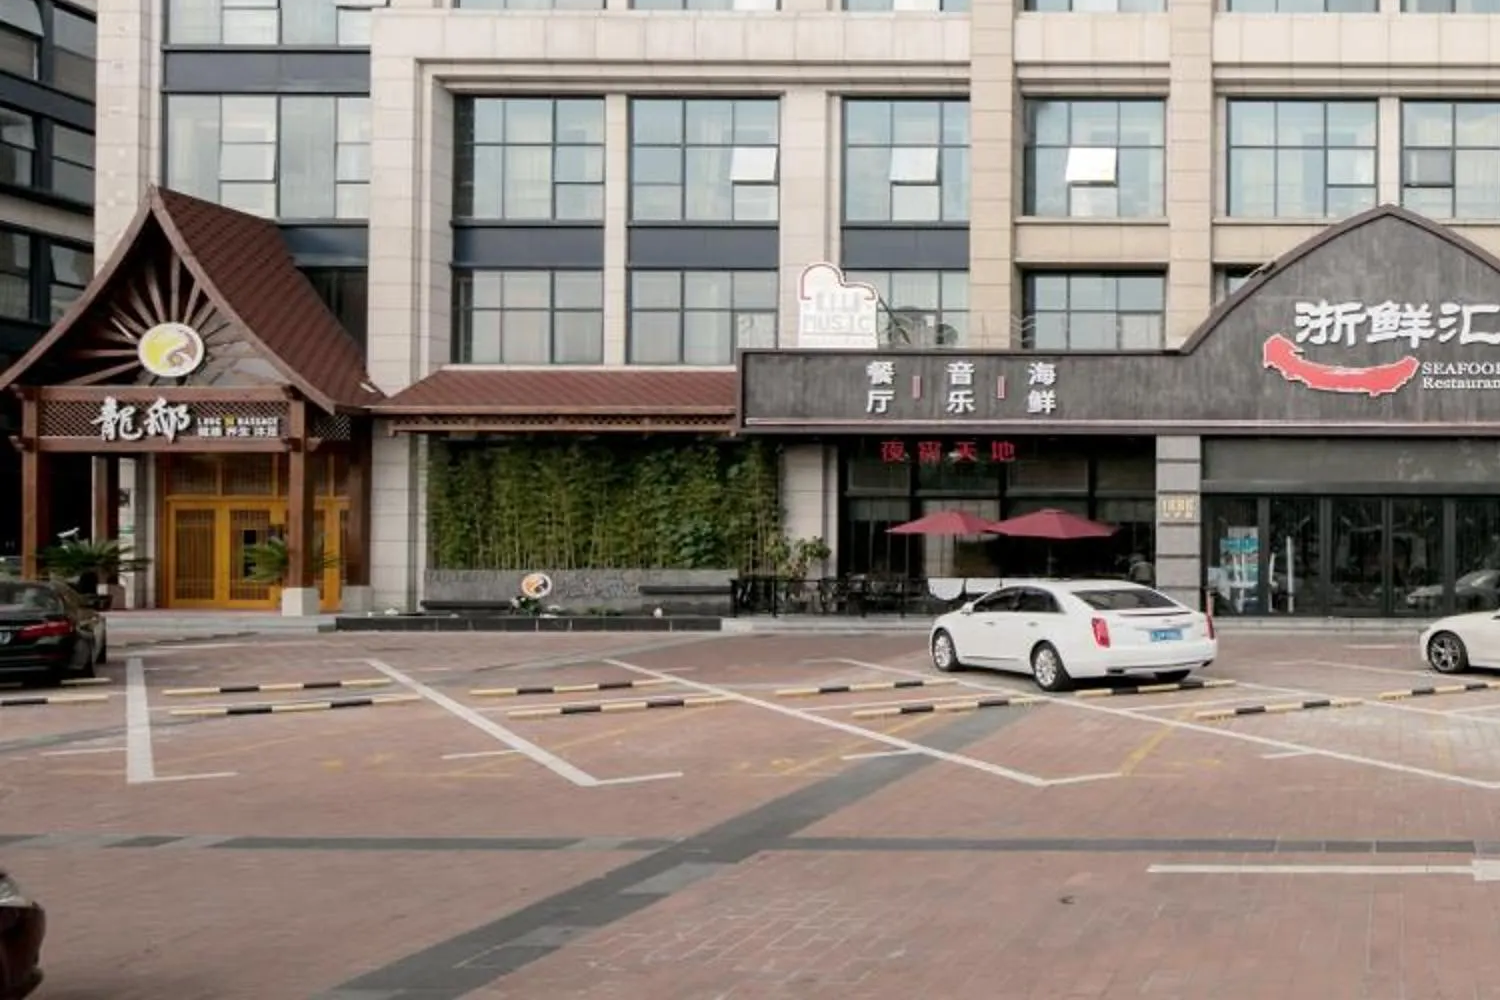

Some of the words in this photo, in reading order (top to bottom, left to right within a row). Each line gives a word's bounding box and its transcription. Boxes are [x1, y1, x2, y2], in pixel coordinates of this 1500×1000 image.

[802, 314, 872, 332] MUSIC
[865, 360, 896, 414] 餐厅
[945, 360, 976, 414] 音乐
[1026, 361, 1058, 415] 海鲜
